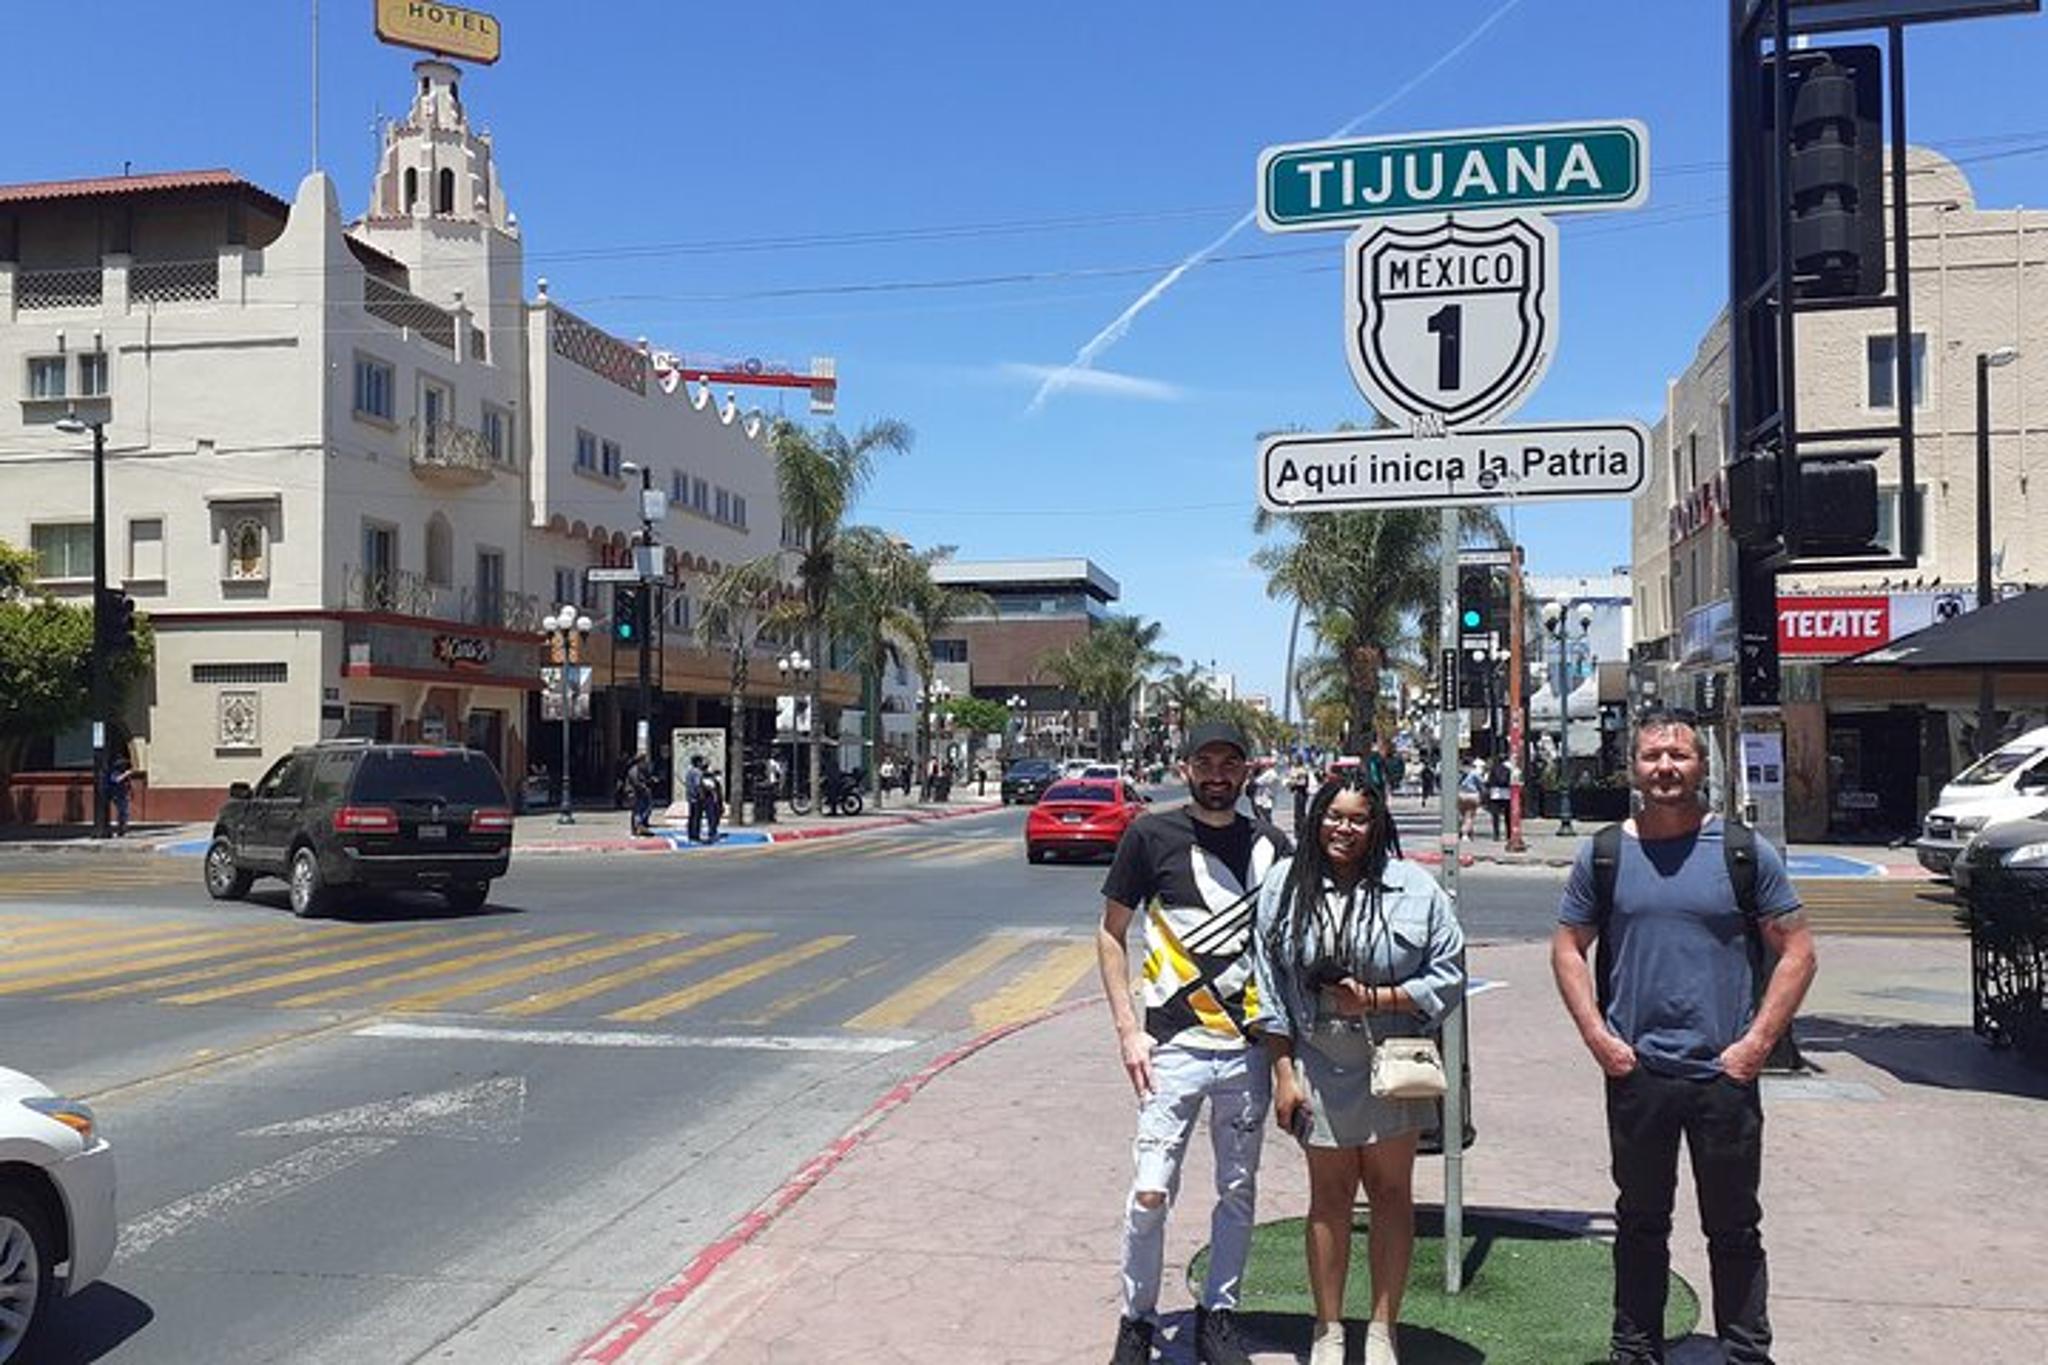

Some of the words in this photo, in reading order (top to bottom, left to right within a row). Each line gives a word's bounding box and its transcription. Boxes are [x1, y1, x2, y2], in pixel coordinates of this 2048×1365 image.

[409, 2, 491, 34] HOTEL
[1297, 143, 1602, 208] TIJUANA
[1390, 253, 1514, 290] MÉXICO
[1428, 304, 1462, 390] 1
[1276, 454, 1358, 494] Aquí
[1370, 453, 1464, 484] inicia
[1479, 449, 1508, 478] la
[1523, 445, 1628, 477] Patria
[1779, 608, 1883, 638] TECATE
